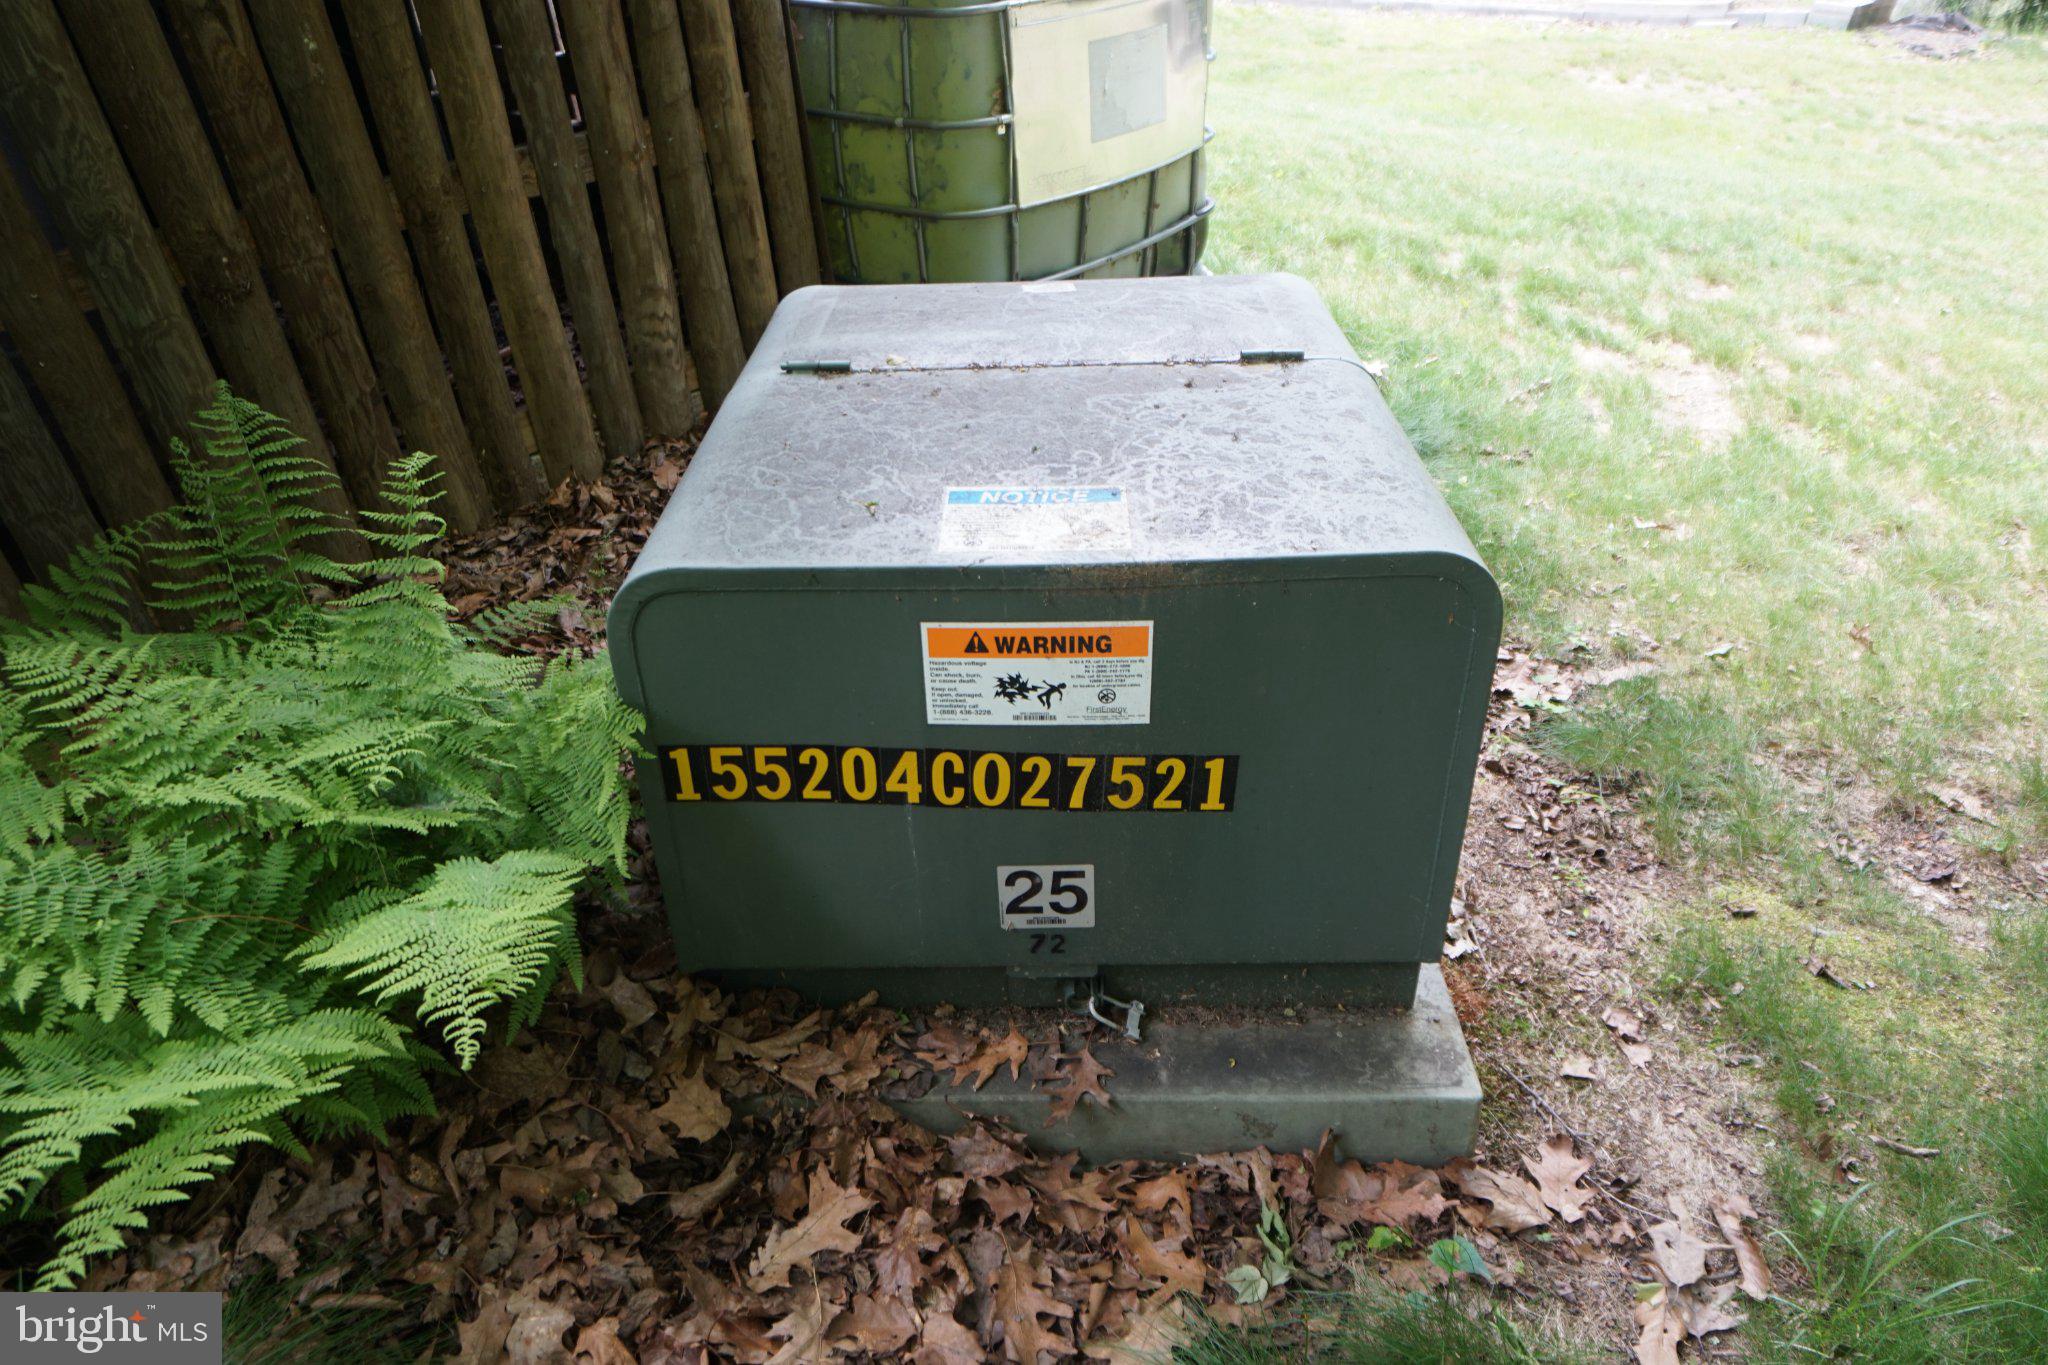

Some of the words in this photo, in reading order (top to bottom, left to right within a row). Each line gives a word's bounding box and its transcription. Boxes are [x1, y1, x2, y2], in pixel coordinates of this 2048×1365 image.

[980, 490, 1090, 504] NOTICE
[994, 635, 1112, 654] WARNING
[1086, 706, 1127, 716] FirstEnergy
[669, 747, 1225, 810] 155204C027521
[1004, 869, 1088, 915] 25
[1030, 933, 1066, 954] 72
